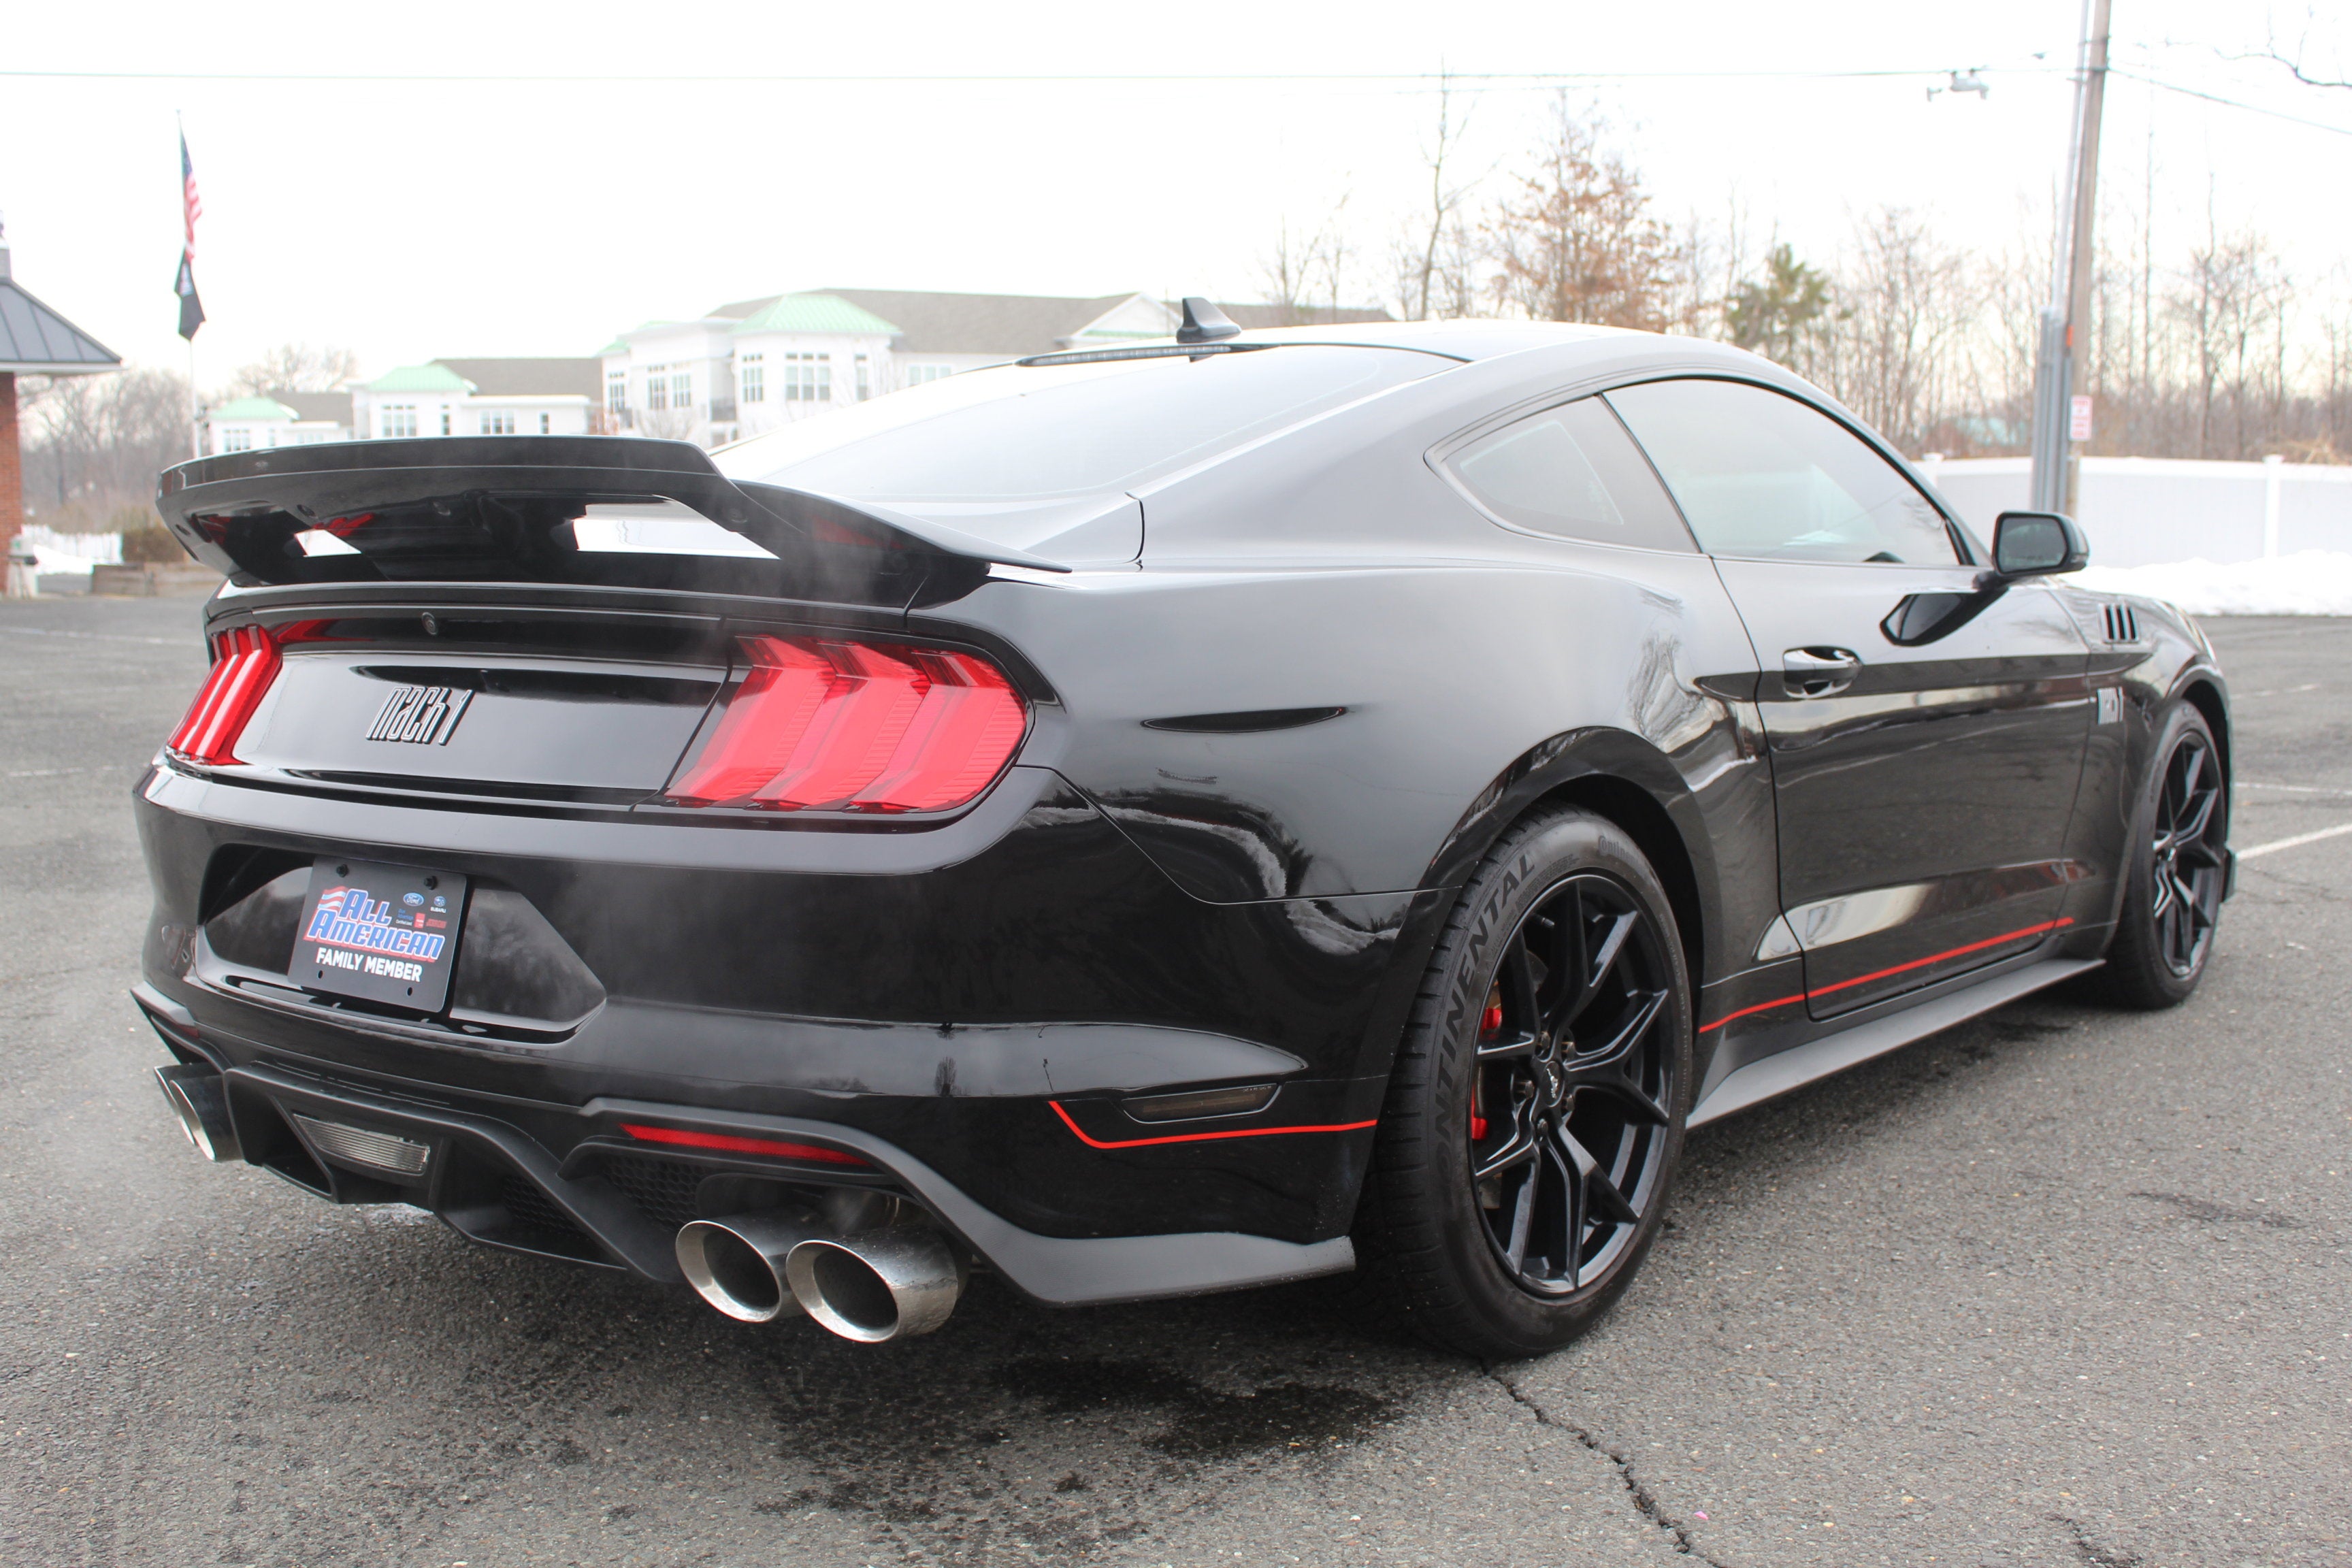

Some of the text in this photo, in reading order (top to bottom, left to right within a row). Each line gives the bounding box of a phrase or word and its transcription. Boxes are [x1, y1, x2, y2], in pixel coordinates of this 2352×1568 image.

[438, 689, 474, 746] 1
[338, 888, 392, 926] ALL
[316, 947, 423, 982] FAMILY MEMBER
